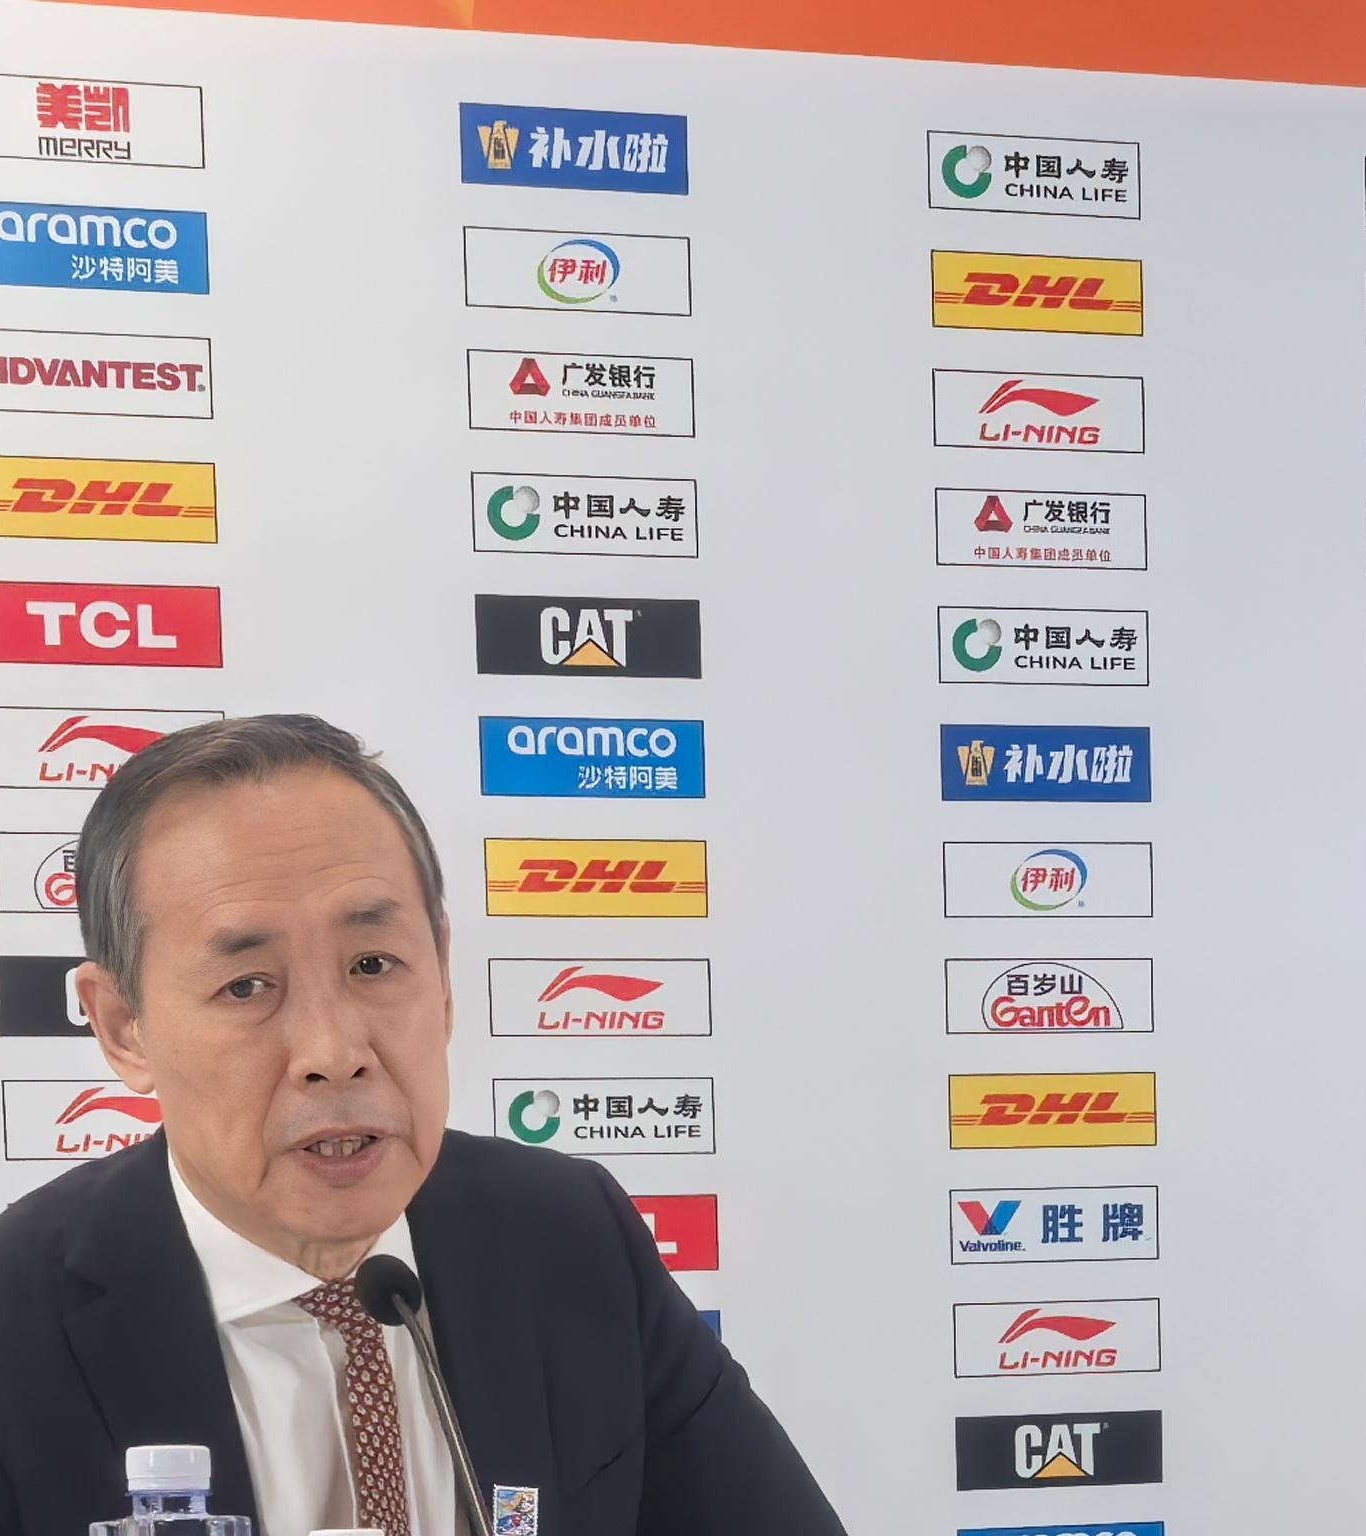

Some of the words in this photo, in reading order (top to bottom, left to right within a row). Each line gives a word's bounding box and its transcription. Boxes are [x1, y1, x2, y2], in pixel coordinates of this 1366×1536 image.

[35, 80, 131, 132] 美凯
[528, 126, 669, 175] 补水啦
[1003, 151, 1129, 185] 中国人寿
[1004, 182, 1073, 200] CHINA
[1081, 187, 1127, 203] LIFE
[68, 254, 180, 285] 沙特阿美
[547, 256, 608, 286] 伊利
[962, 271, 1114, 311] DHL
[560, 361, 656, 389] 广发银行
[978, 422, 1101, 445] LI-NING
[10, 477, 184, 517] DHL
[552, 491, 685, 523] 中国人寿
[1022, 498, 1111, 525] 广发银行
[553, 523, 626, 540] CHINA
[635, 526, 684, 542] LIFE
[25, 598, 178, 649] TCL
[538, 607, 634, 666] CAT
[1013, 624, 1137, 653] 中国人寿
[1014, 655, 1082, 670] CHINA
[1090, 656, 1136, 671] LIFE
[506, 725, 677, 757] aramco
[575, 765, 678, 790] 沙特阿美
[1003, 744, 1134, 784] 补水啦
[517, 859, 677, 893] DHL
[1020, 866, 1076, 892] 伊利
[1006, 973, 1084, 996] 百岁山
[536, 1010, 666, 1029] LI-NING
[571, 1093, 703, 1121] 中国人寿
[978, 1092, 1127, 1125] DHL
[573, 1125, 645, 1140] CHINA
[653, 1124, 702, 1139] LIFE
[997, 1348, 1118, 1370] LI-NING
[1013, 1422, 1101, 1479] CAT
